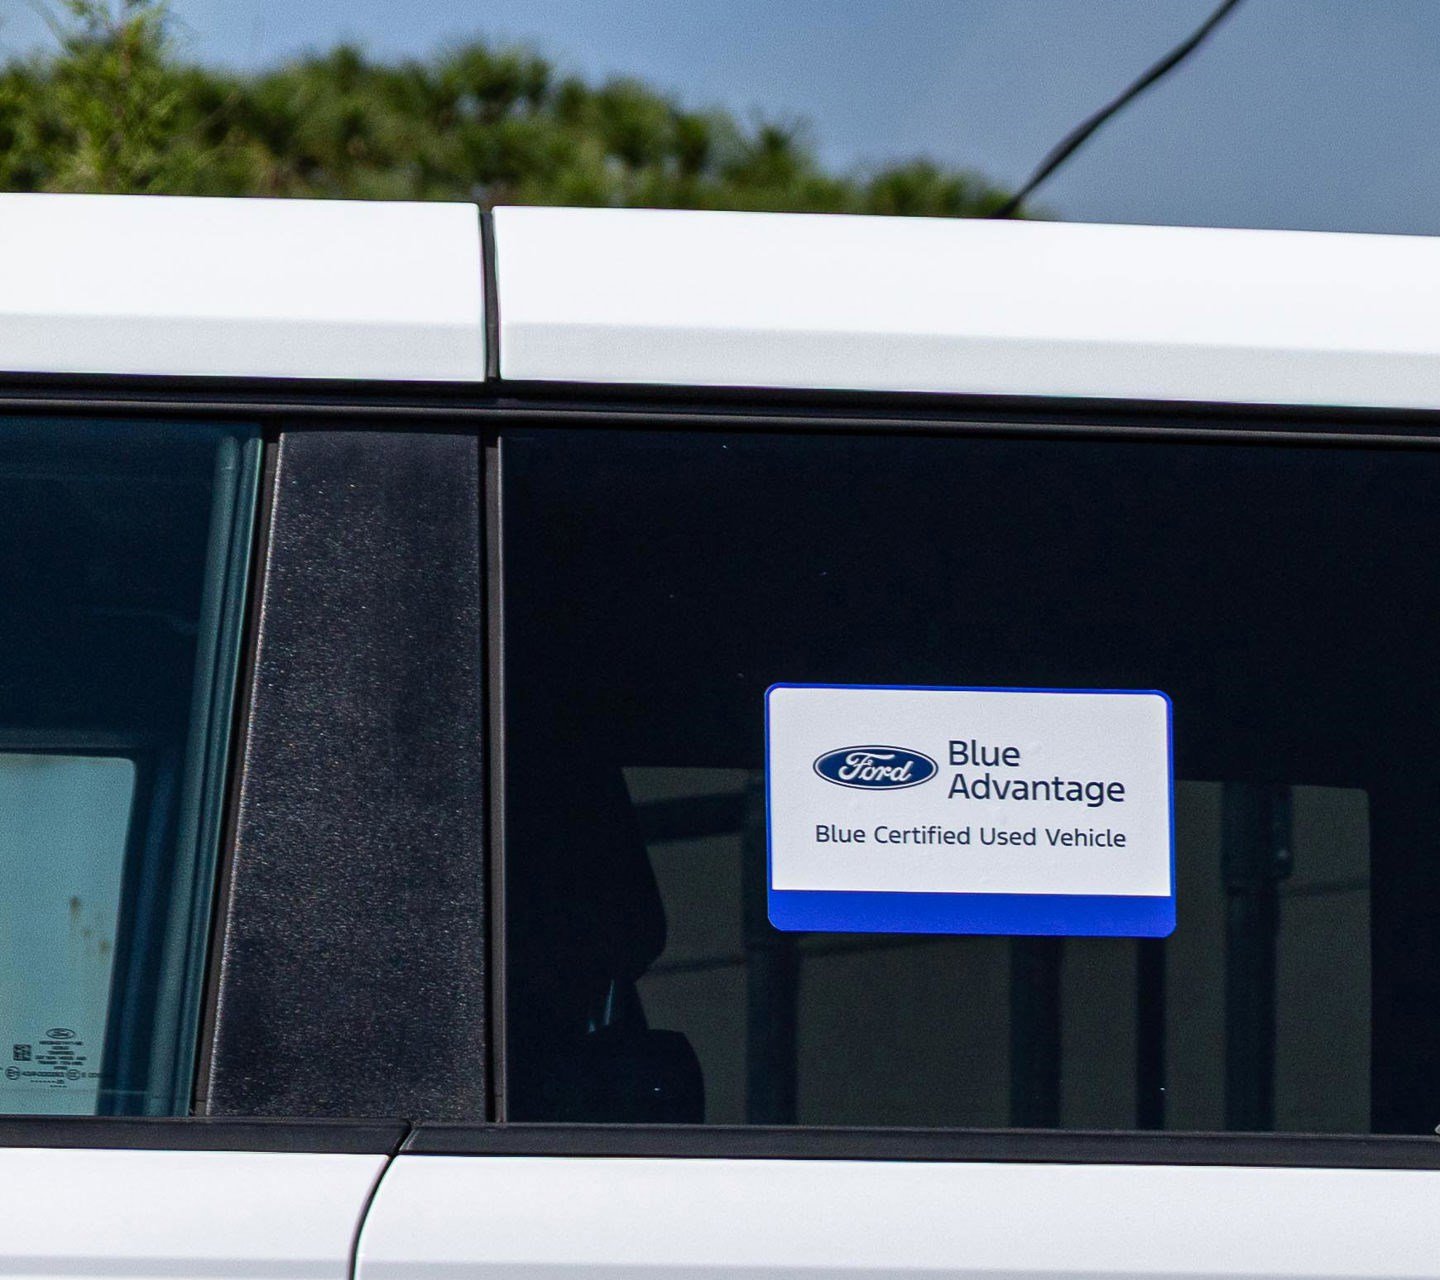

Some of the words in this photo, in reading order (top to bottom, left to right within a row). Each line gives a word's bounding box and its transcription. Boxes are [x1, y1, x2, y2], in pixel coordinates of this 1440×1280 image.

[949, 739, 1021, 768] Blue
[948, 772, 1126, 808] Advantage
[815, 824, 867, 844] Blue
[873, 825, 971, 846] Certified
[980, 827, 1037, 847] Used
[1045, 828, 1127, 849] Vehicle
